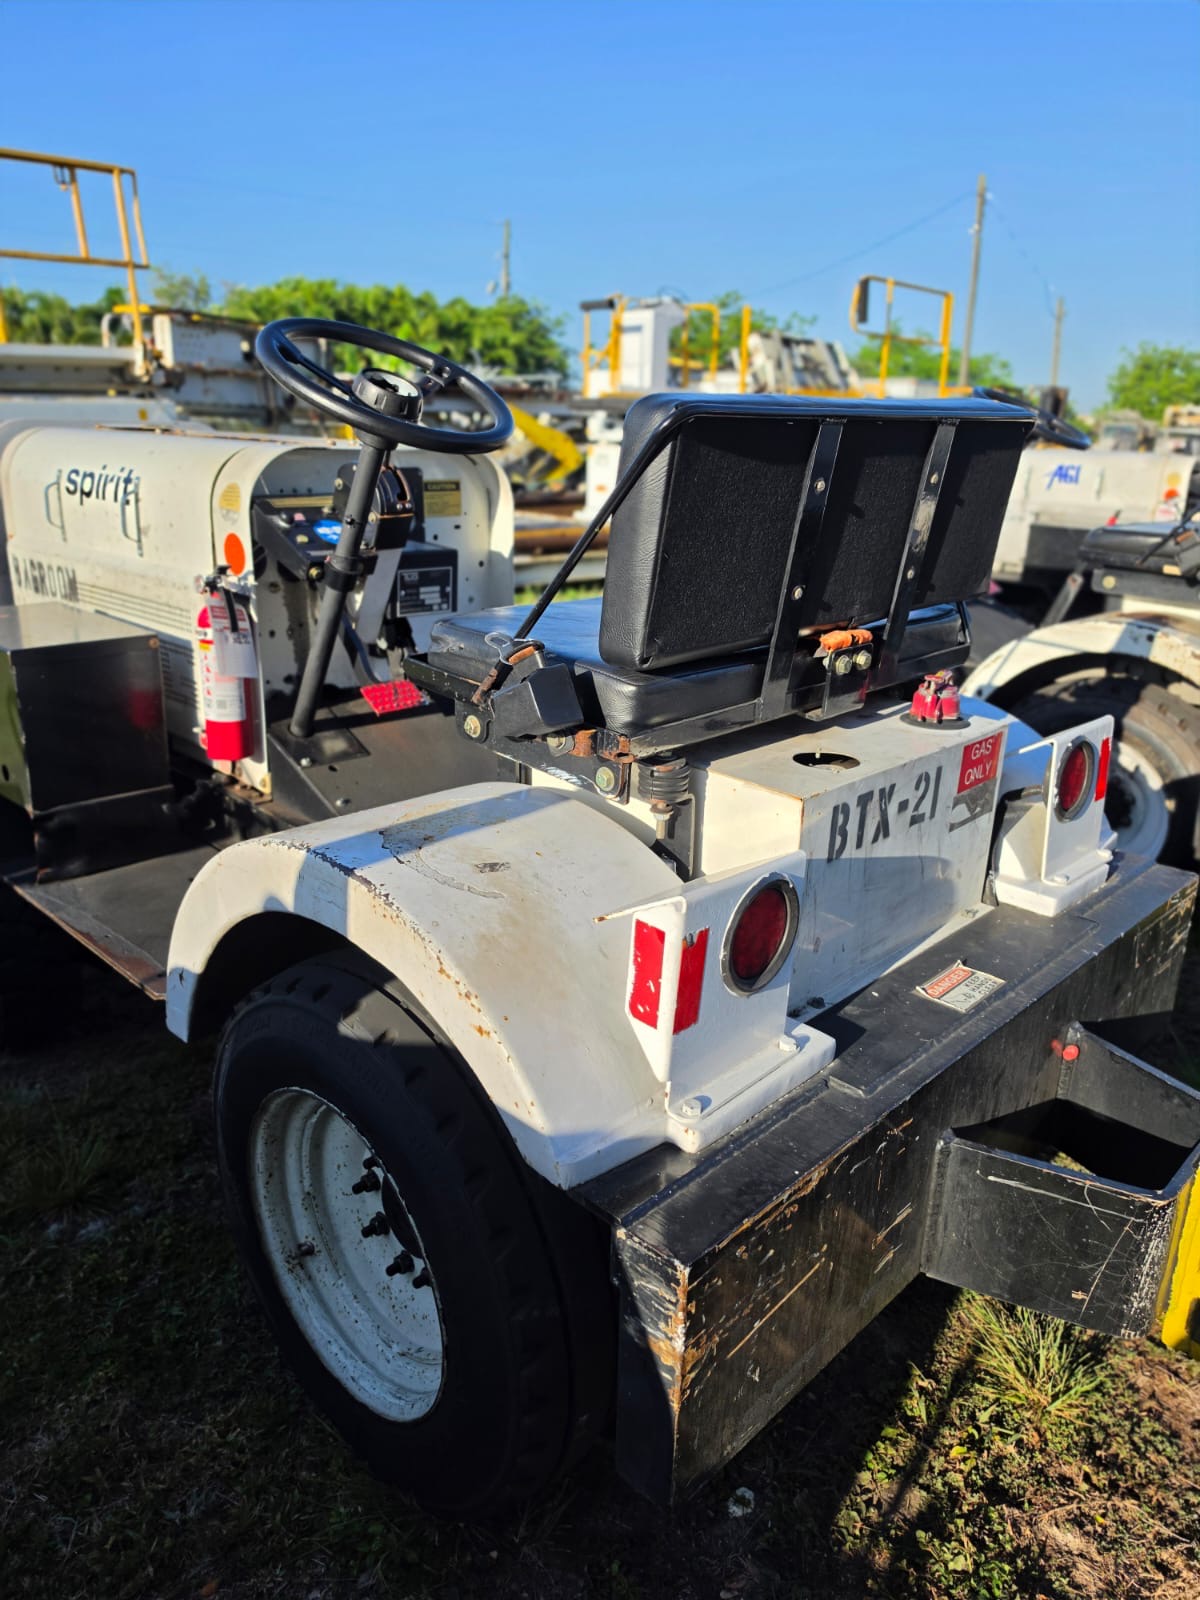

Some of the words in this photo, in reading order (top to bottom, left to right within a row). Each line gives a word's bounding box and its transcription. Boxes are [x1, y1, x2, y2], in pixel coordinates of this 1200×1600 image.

[65, 464, 134, 506] spirit
[971, 738, 993, 761] GAS
[964, 761, 993, 785] ONLY
[827, 765, 943, 864] BTX-21
[930, 969, 966, 996] DANGER
